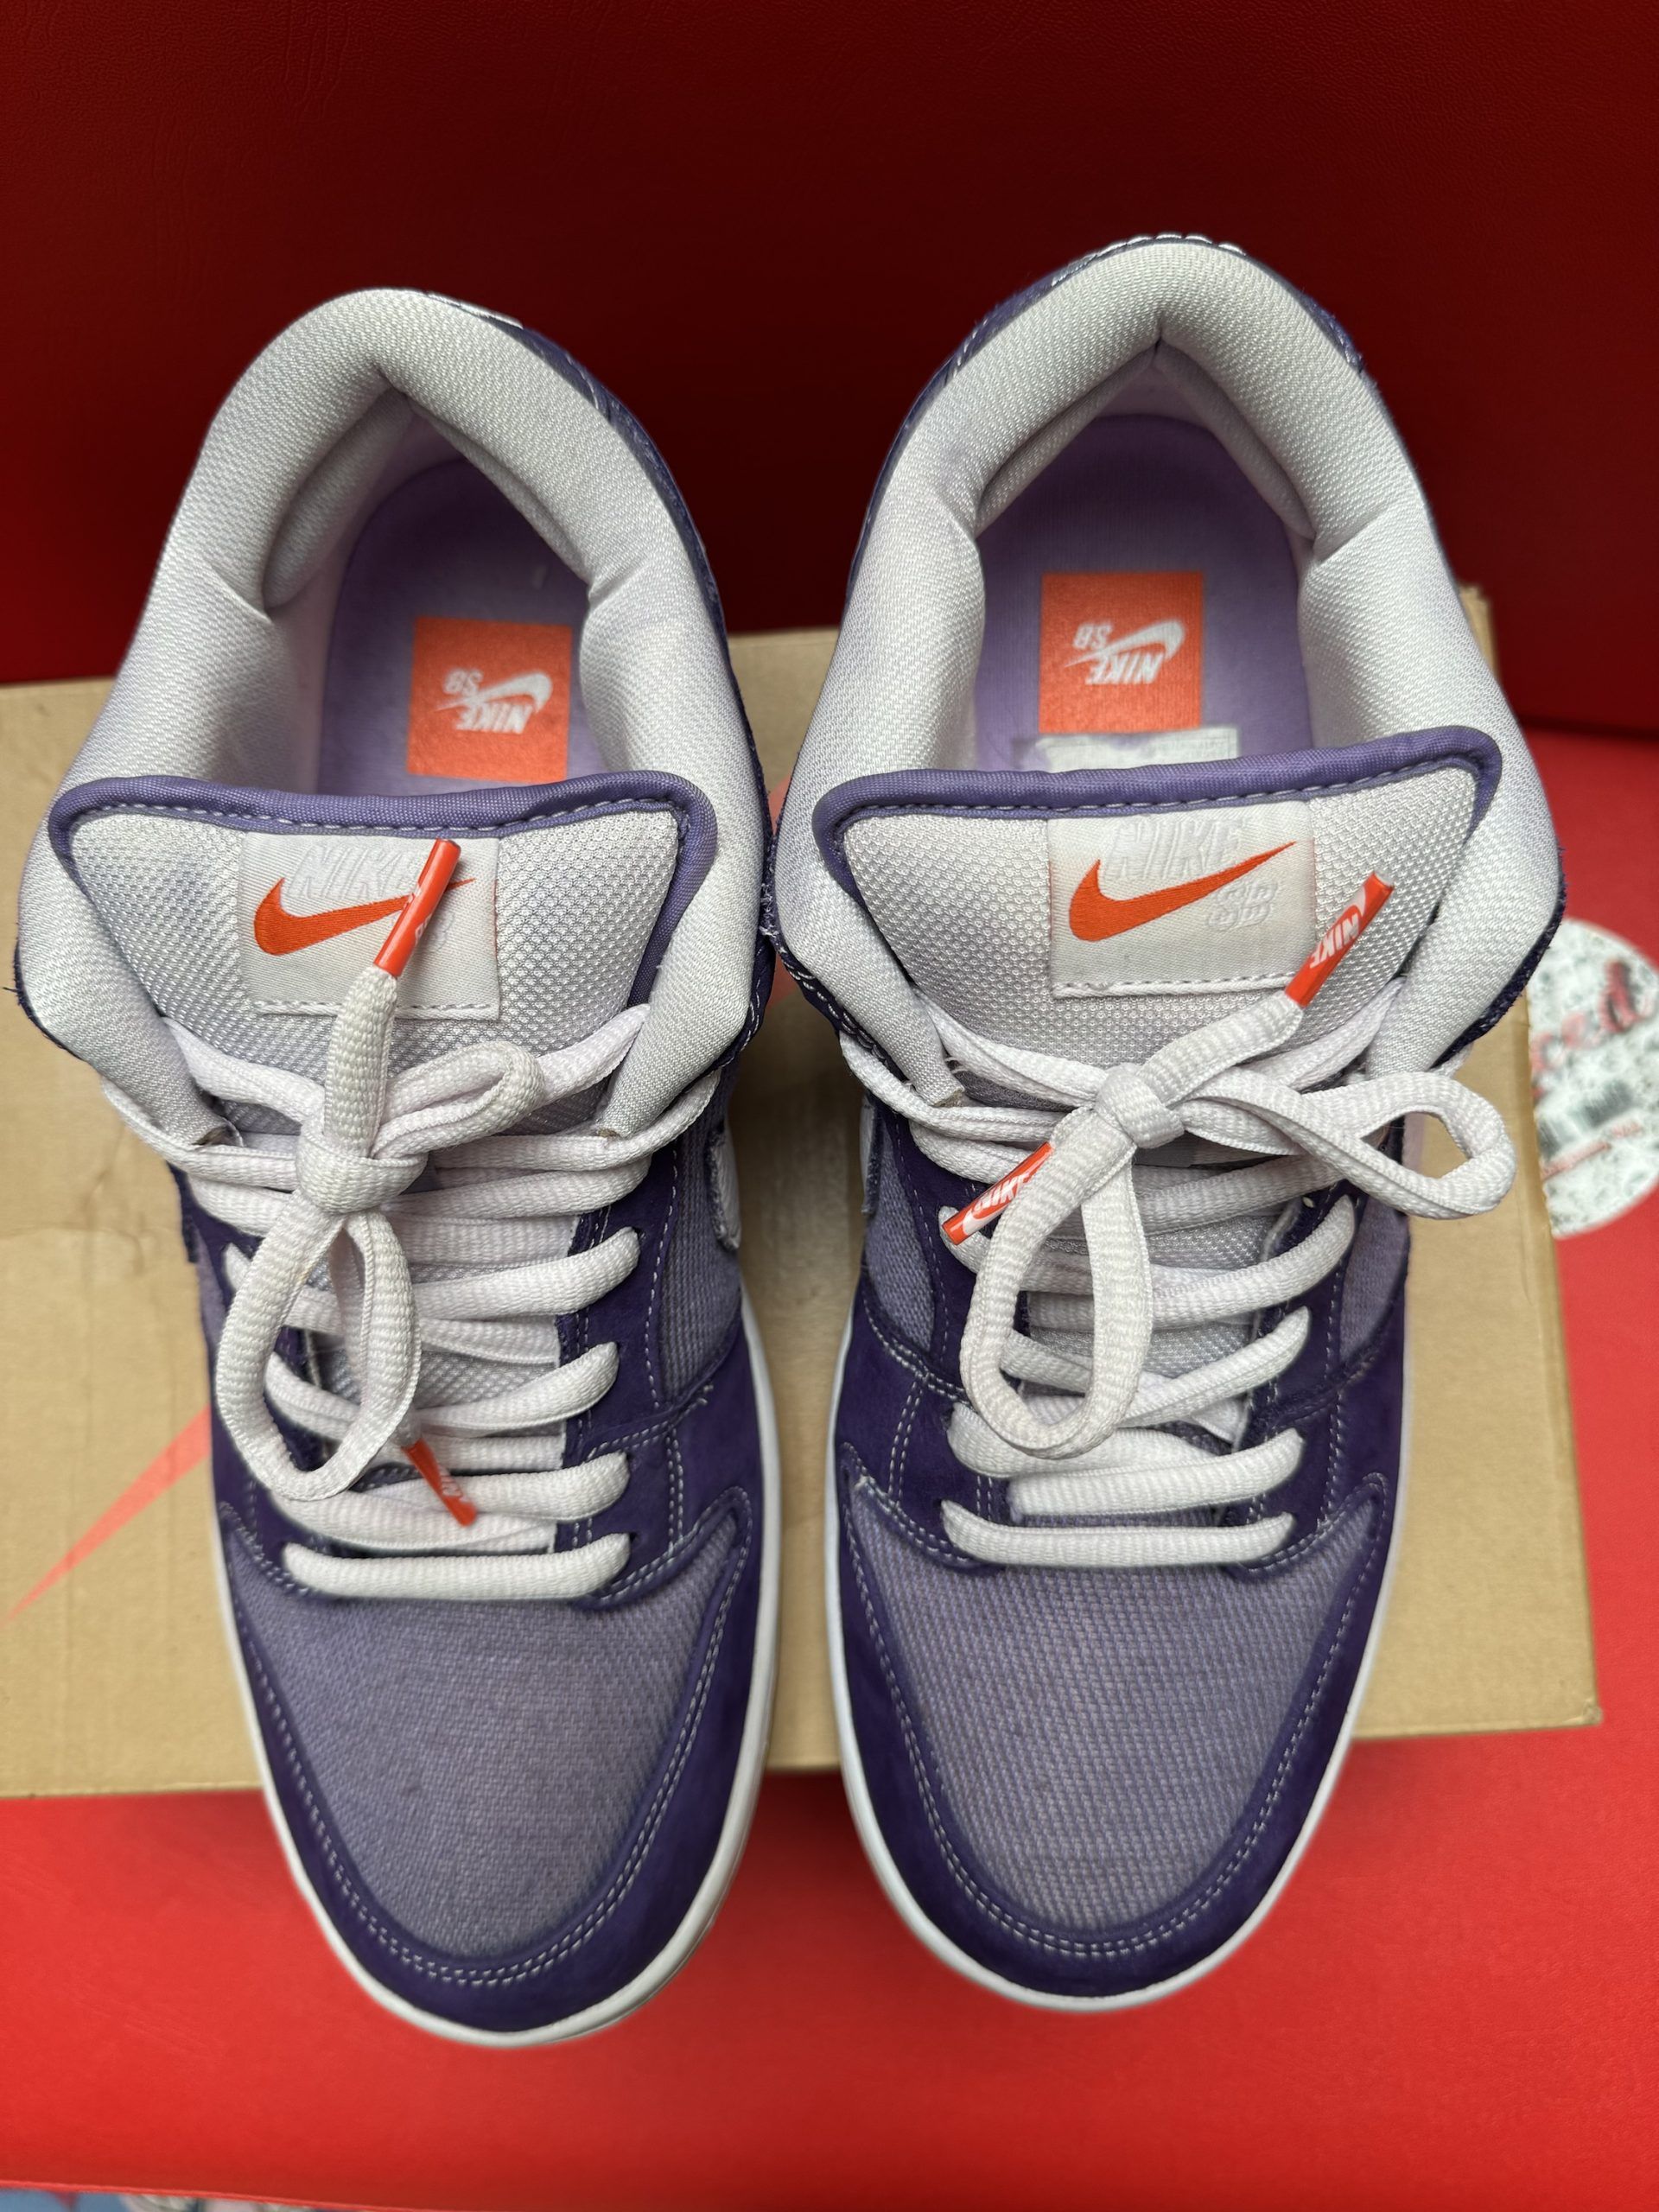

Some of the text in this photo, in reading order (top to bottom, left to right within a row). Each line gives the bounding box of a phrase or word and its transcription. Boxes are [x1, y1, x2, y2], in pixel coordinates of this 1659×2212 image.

[1072, 623, 1115, 650] SB
[442, 669, 484, 696] SB
[1085, 651, 1164, 684] NIKE
[455, 702, 533, 734] NIKE
[1102, 818, 1248, 880] NIKE
[1206, 876, 1279, 932] SB
[1310, 912, 1360, 969] NIKE
